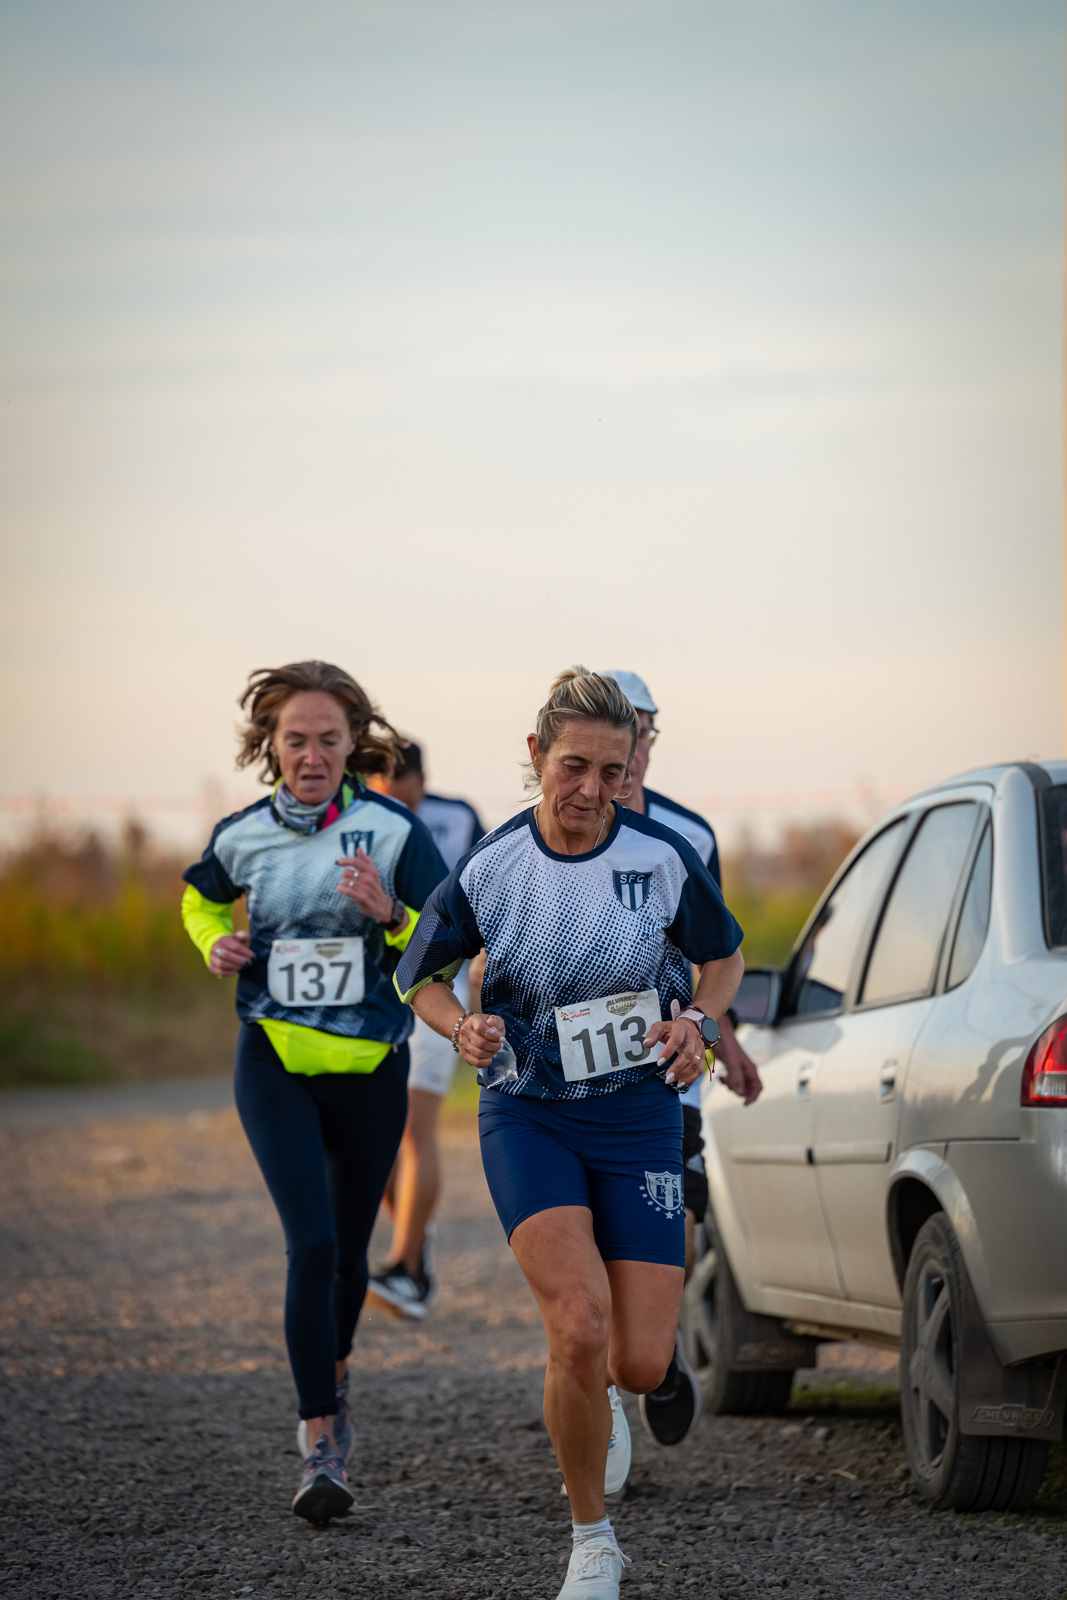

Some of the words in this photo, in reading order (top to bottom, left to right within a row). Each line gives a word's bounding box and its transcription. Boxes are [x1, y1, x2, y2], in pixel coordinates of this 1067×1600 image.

[620, 874, 645, 884] SFC
[278, 961, 352, 1002] 137
[608, 1000, 637, 1012] CORRE
[571, 1016, 651, 1073] 113
[655, 1176, 678, 1187] SFC
